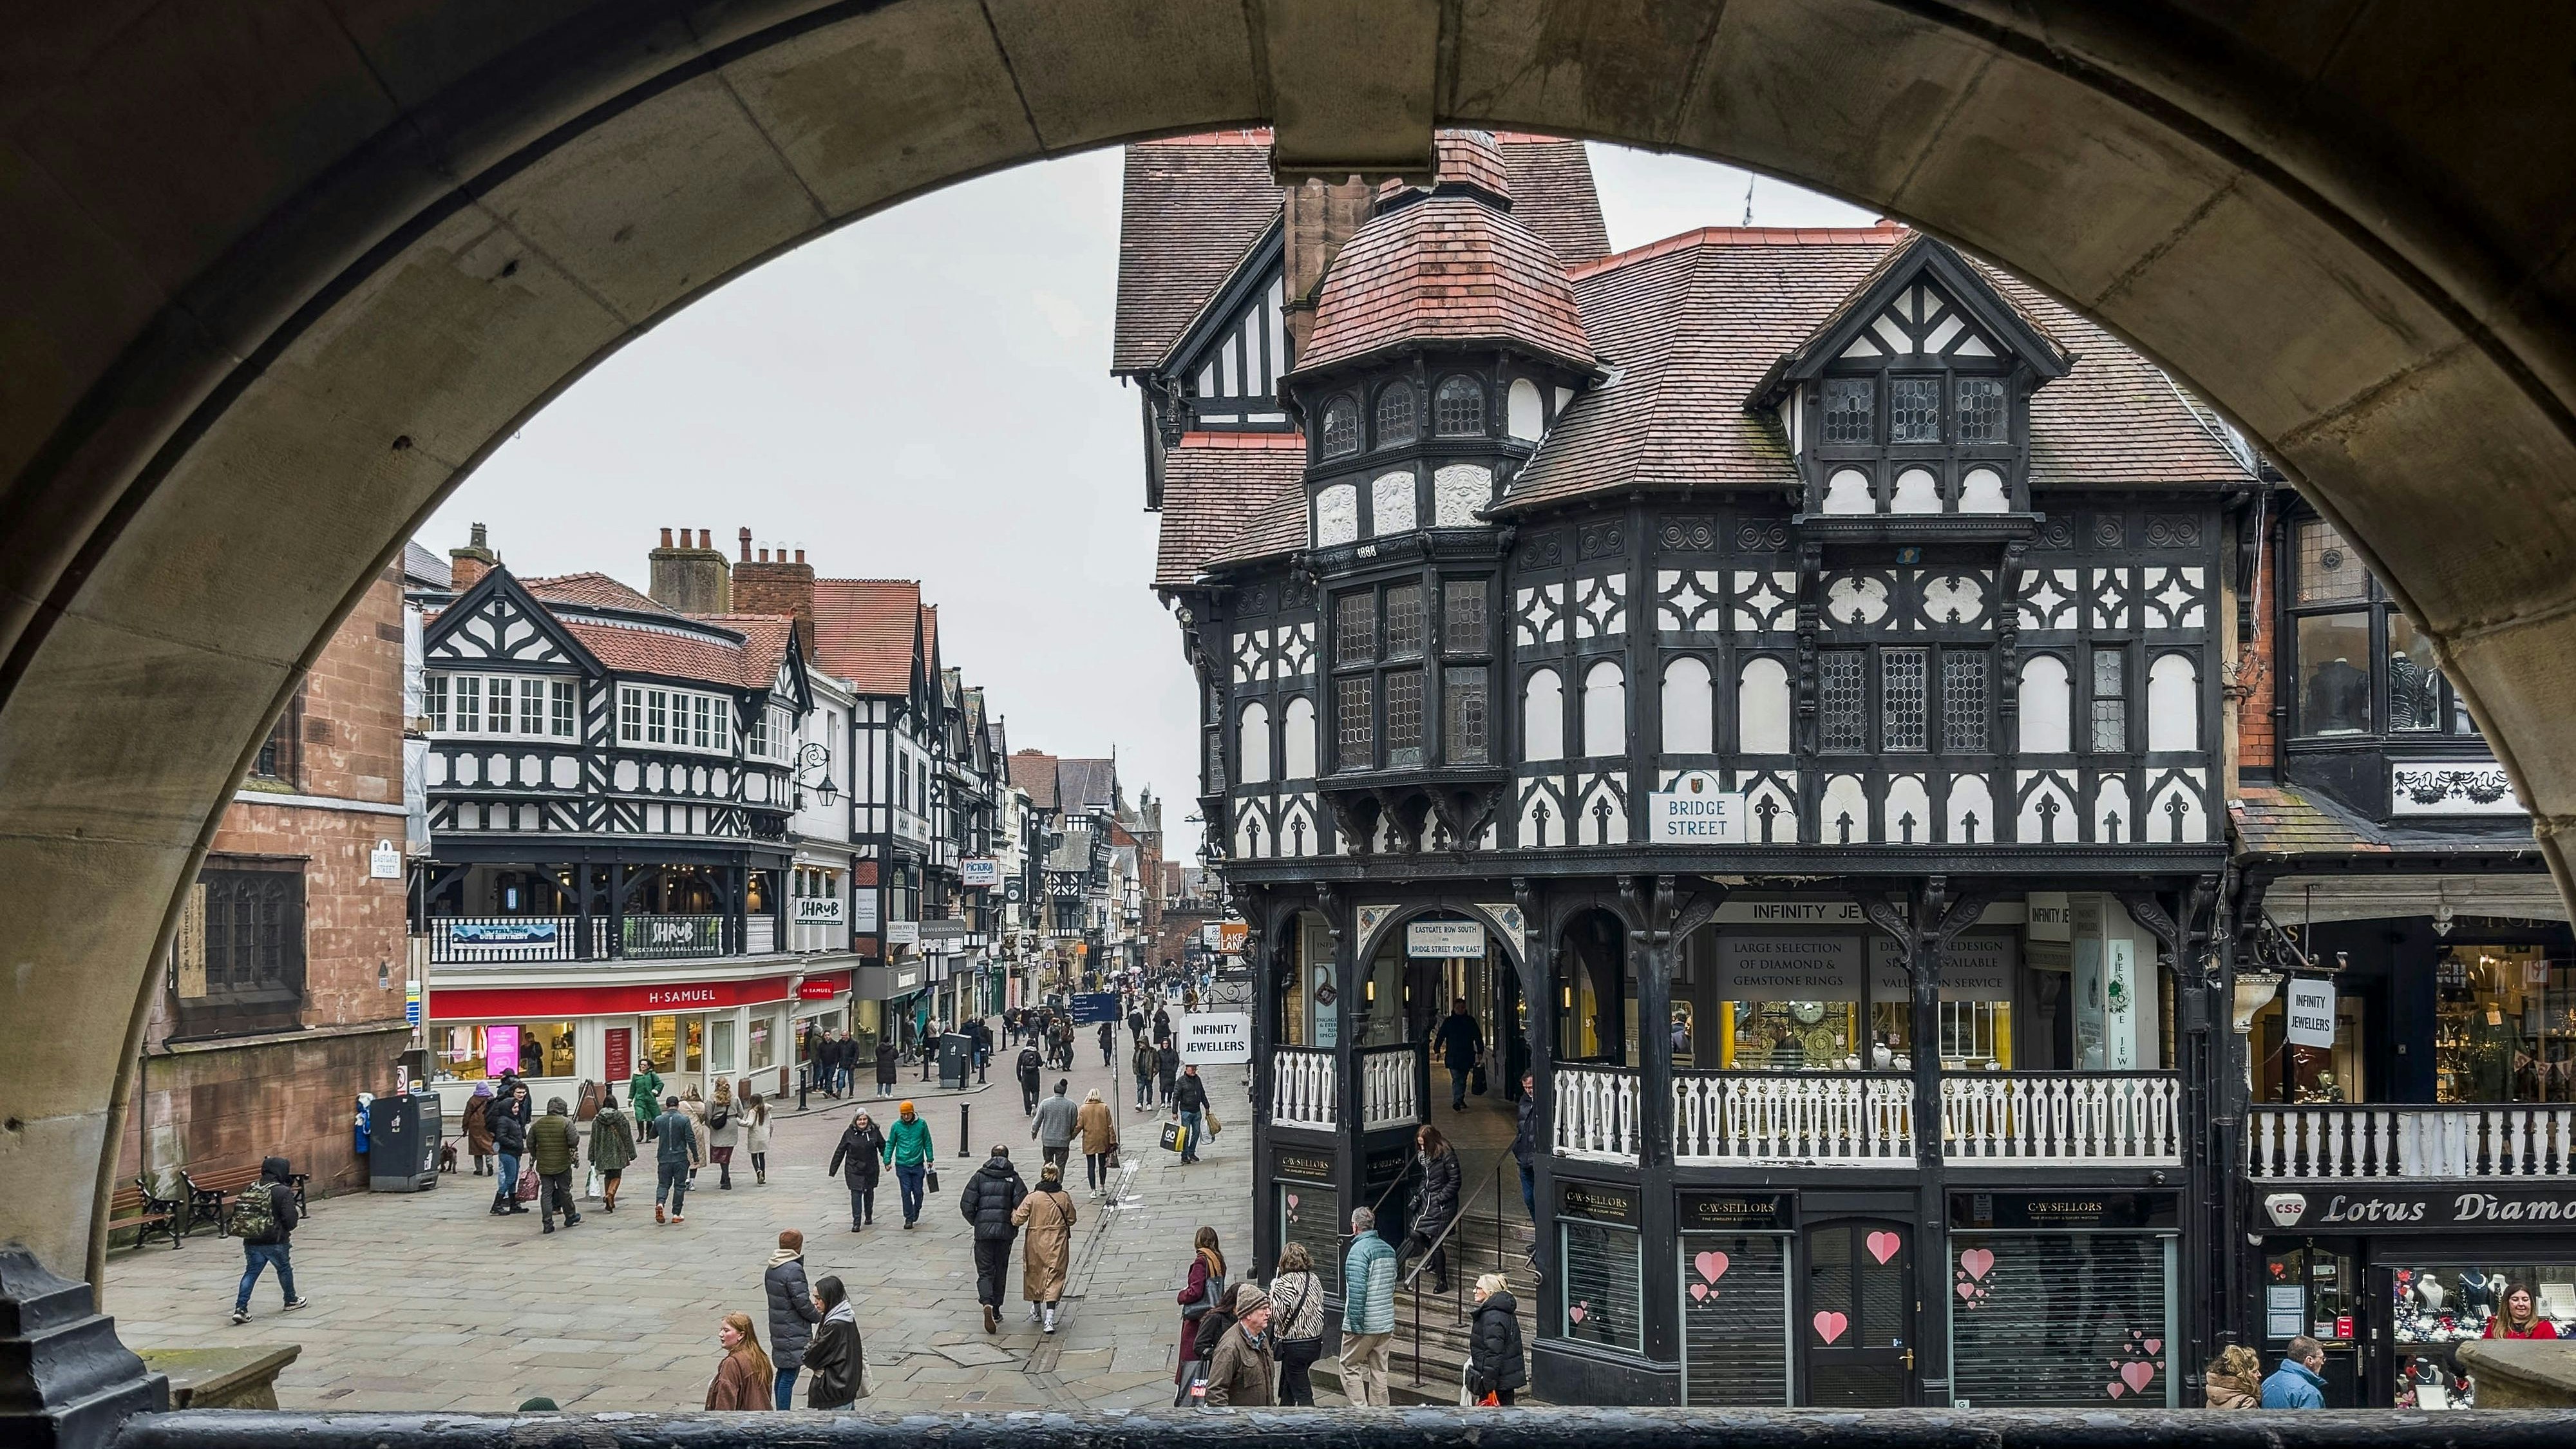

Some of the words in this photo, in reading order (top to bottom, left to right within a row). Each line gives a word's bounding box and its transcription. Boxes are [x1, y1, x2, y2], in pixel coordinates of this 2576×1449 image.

[1669, 800, 1725, 815] BRIDGE
[1668, 820, 1727, 835] STREET
[1754, 904, 1826, 918] INFINITY
[2032, 907, 2060, 923] INFINITY
[1220, 933, 1244, 942] LAKE
[1734, 943, 1771, 953] LARGE
[1775, 943, 1842, 953] SELECTION
[1740, 960, 1756, 969] OF
[1760, 960, 1823, 969] DIAMOND
[1826, 960, 1835, 969] &
[1734, 976, 1801, 986] GEMSTONE
[1805, 976, 1843, 986] RINGS
[1955, 978, 2003, 988] SERVICE
[2296, 994, 2325, 1009] INFINITY
[1193, 1024, 1237, 1035] INFINITY
[2291, 1016, 2330, 1032] JEWELLERS
[1186, 1041, 1245, 1052] JEWELLERS
[1166, 1130, 1175, 1139] GO
[2320, 1195, 2426, 1222] Lotus
[2453, 1193, 2576, 1221] Diamo
[2307, 1237, 2313, 1247] 3
